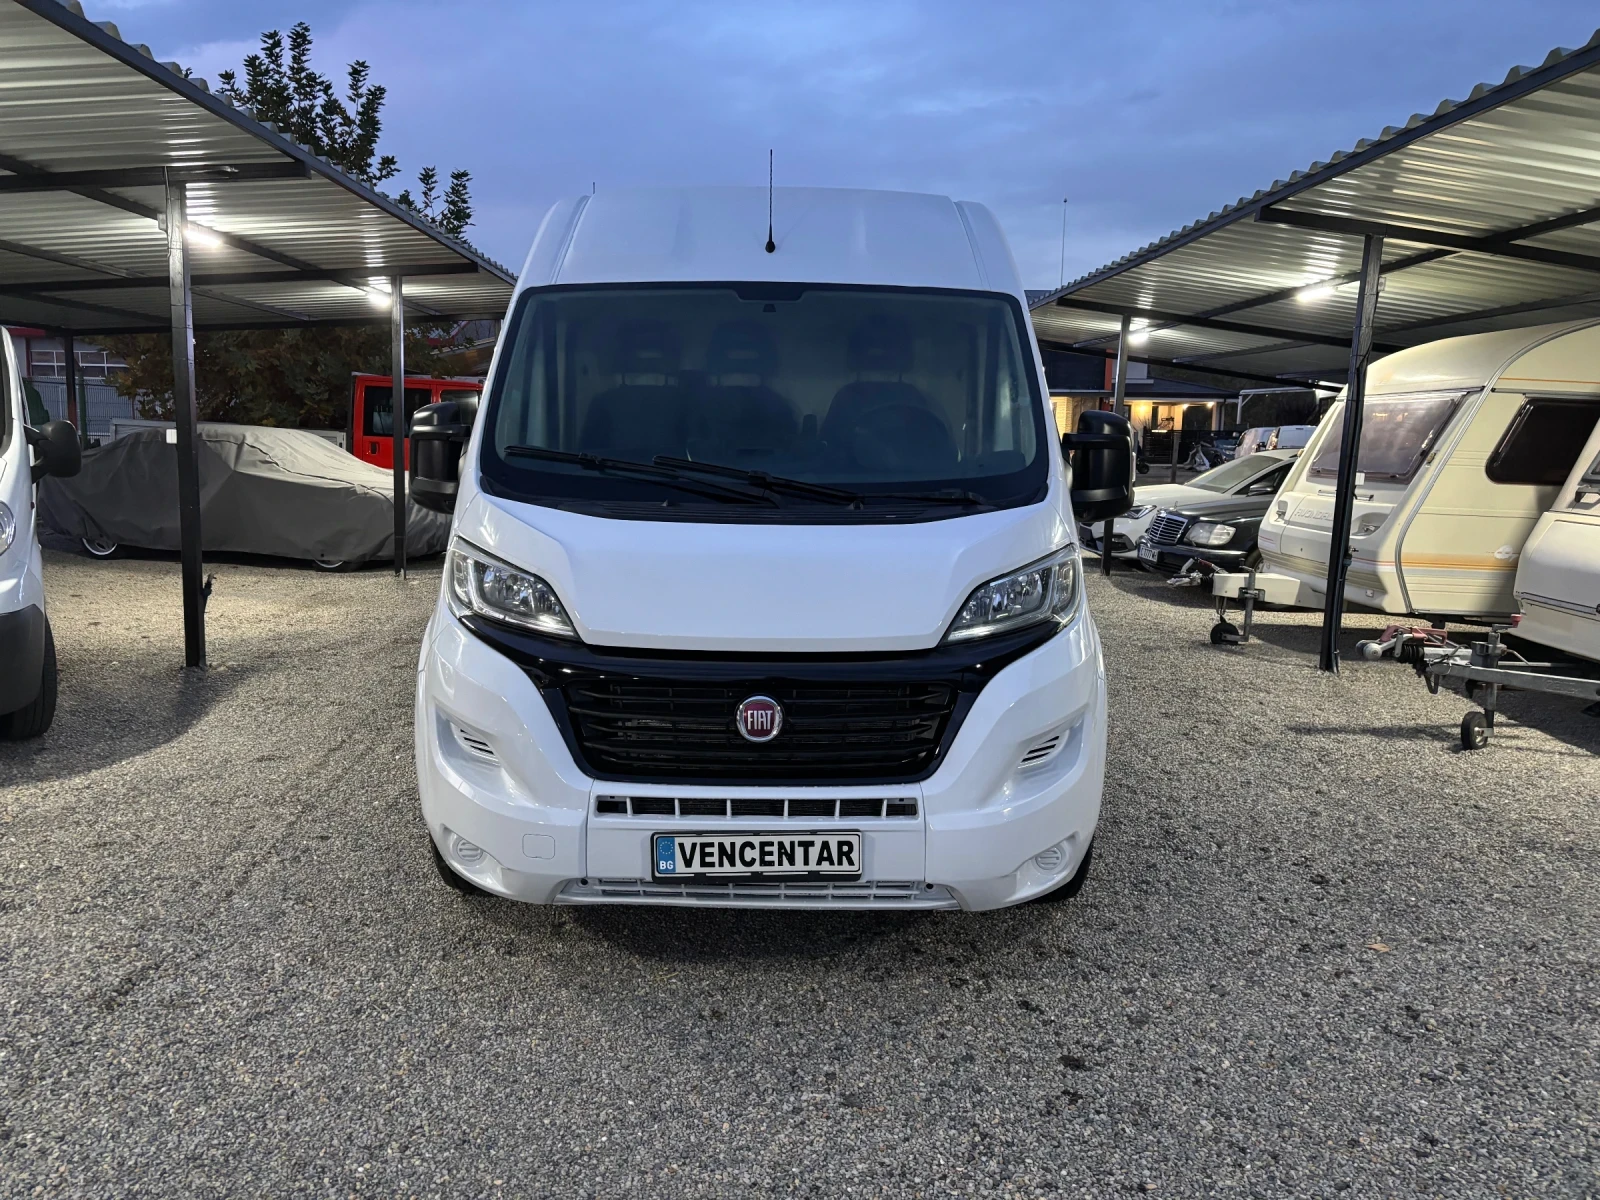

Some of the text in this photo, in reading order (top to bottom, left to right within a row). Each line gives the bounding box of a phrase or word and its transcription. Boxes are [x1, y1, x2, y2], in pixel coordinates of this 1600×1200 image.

[747, 710, 773, 730] FIAT
[678, 840, 856, 868] VENCENTAR
[660, 860, 674, 870] BG
